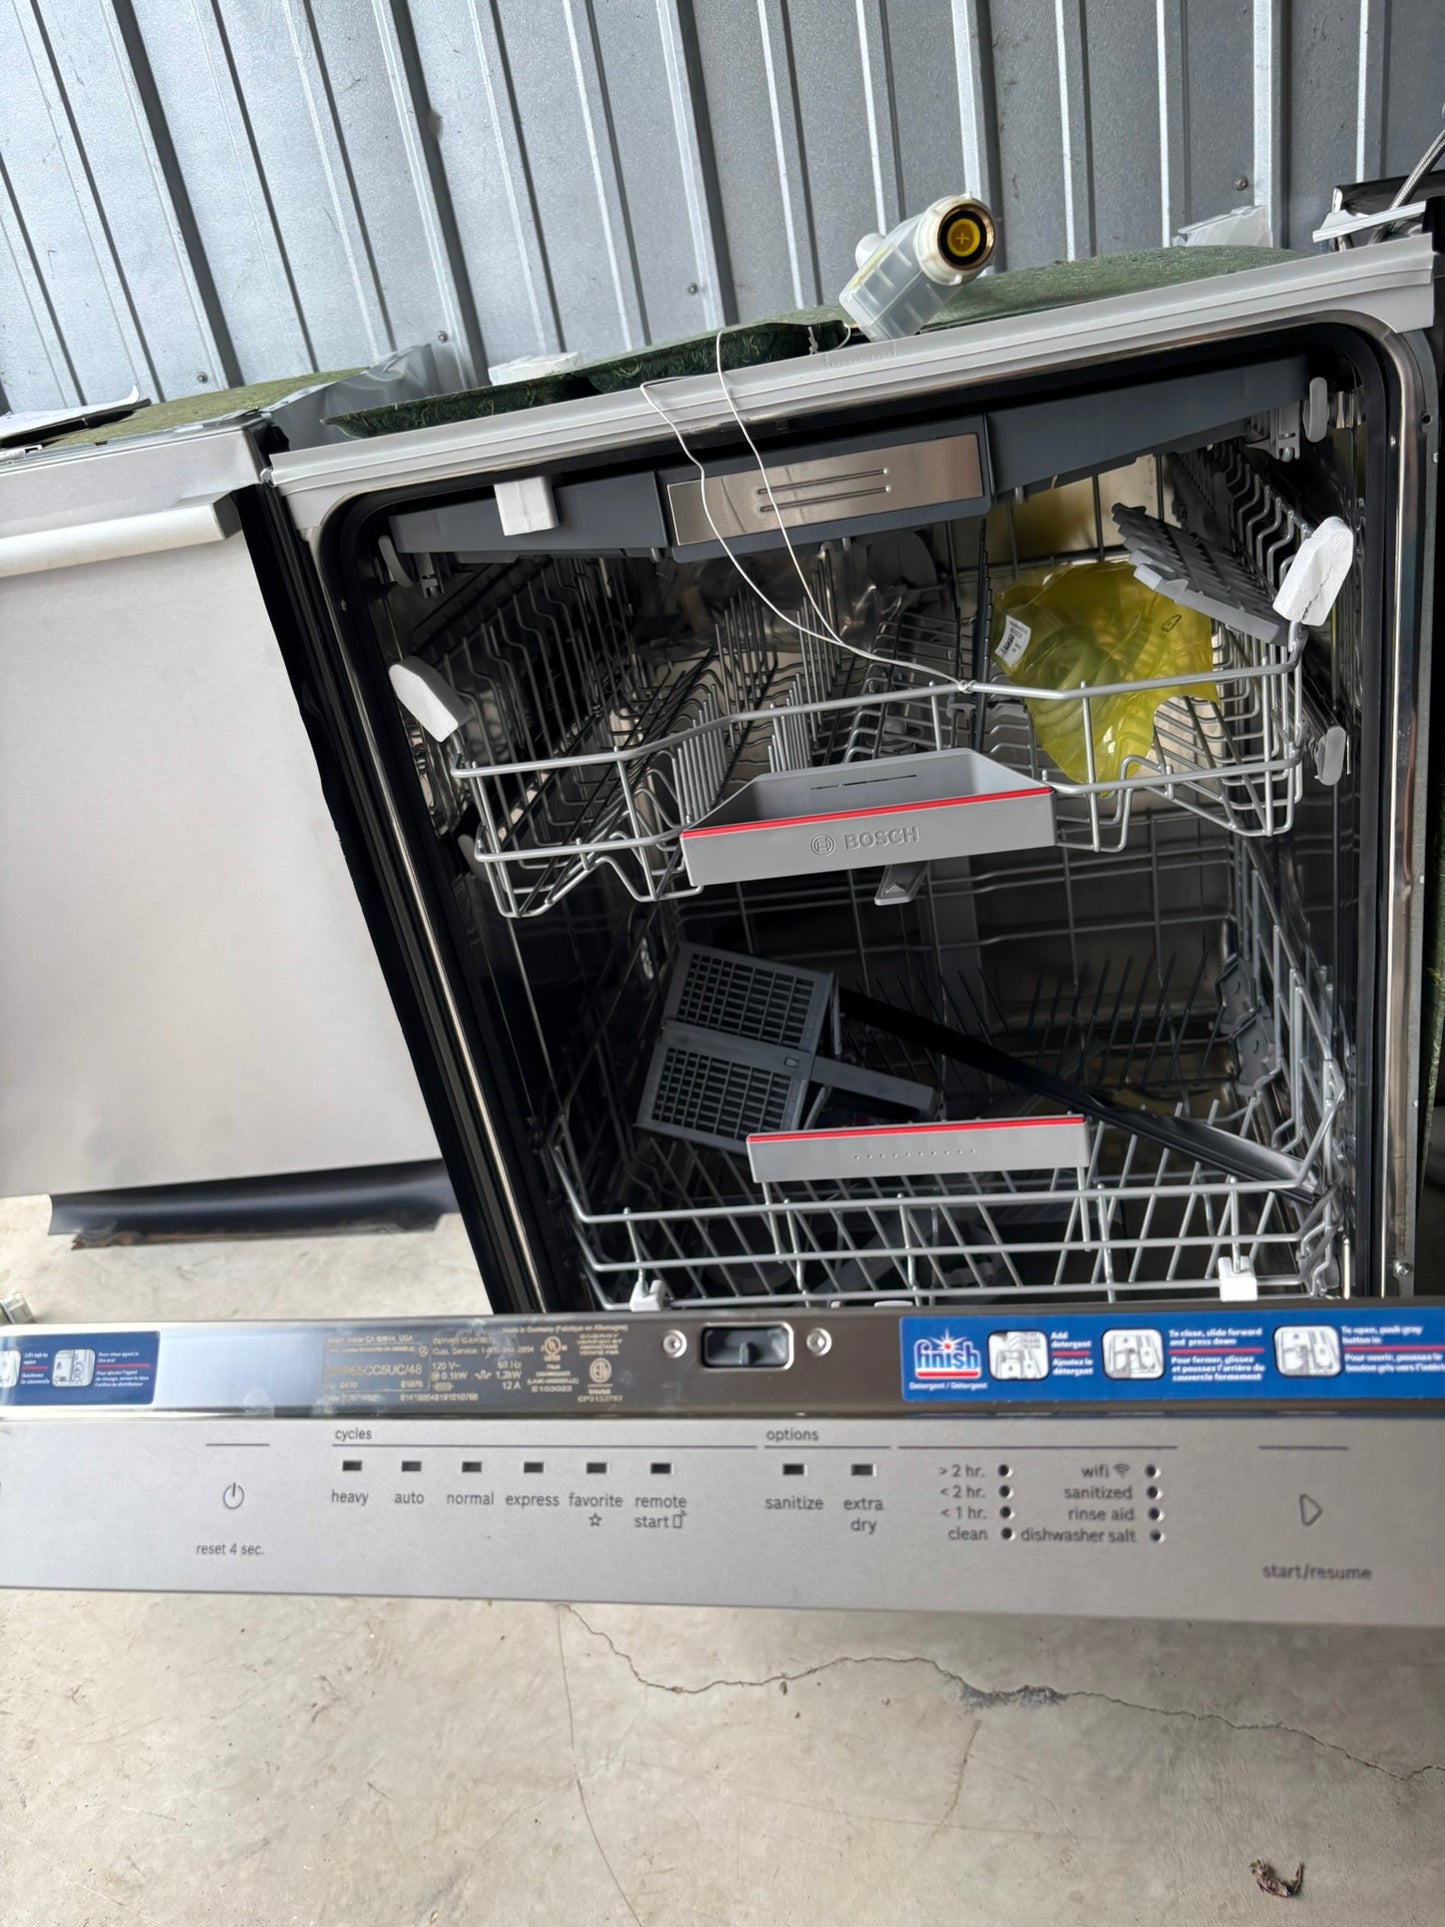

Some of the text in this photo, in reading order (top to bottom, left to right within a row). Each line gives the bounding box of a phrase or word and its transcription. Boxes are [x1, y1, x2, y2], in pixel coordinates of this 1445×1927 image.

[844, 826, 921, 851] BOSCH
[1051, 1331, 1068, 1339] Add
[1168, 1327, 1262, 1337] To close, slide forward
[1340, 1325, 1352, 1335] To
[1051, 1340, 1092, 1349] detergent
[1169, 1338, 1236, 1347] and press down
[1342, 1335, 1371, 1345] button
[914, 1337, 982, 1371] finish
[1170, 1355, 1191, 1364] Pour
[432, 1361, 447, 1369] 120
[1052, 1358, 1083, 1367] Ajoutez
[1171, 1364, 1181, 1372] et
[1182, 1364, 1216, 1372] poussez
[1253, 1364, 1265, 1372] du
[1172, 1373, 1214, 1382] couvercle
[502, 1381, 521, 1389] 12 A
[335, 1428, 372, 1442] cycles
[766, 1428, 819, 1442] options
[952, 1464, 962, 1477] 2
[966, 1464, 986, 1477] hr.
[1081, 1464, 1110, 1478] wifi
[332, 1490, 369, 1506] heavy
[395, 1491, 425, 1504] auto
[447, 1491, 494, 1505] normal
[953, 1485, 962, 1498] 2
[966, 1485, 986, 1498] hr.
[1064, 1486, 1133, 1500] sanitized
[506, 1493, 560, 1508] express
[569, 1492, 623, 1507] favorite
[635, 1494, 687, 1508] remote
[765, 1495, 824, 1510] sanitize
[844, 1497, 884, 1511] extra
[956, 1507, 962, 1519] 1
[968, 1507, 988, 1519] hr.
[1068, 1507, 1135, 1520] rinse aid
[635, 1514, 669, 1528] start
[851, 1518, 877, 1535] dry
[948, 1527, 988, 1541] clean
[1021, 1528, 1136, 1542] dishwasher salt
[196, 1541, 265, 1556] reset 4 sec.
[1262, 1563, 1372, 1580] start/resume
